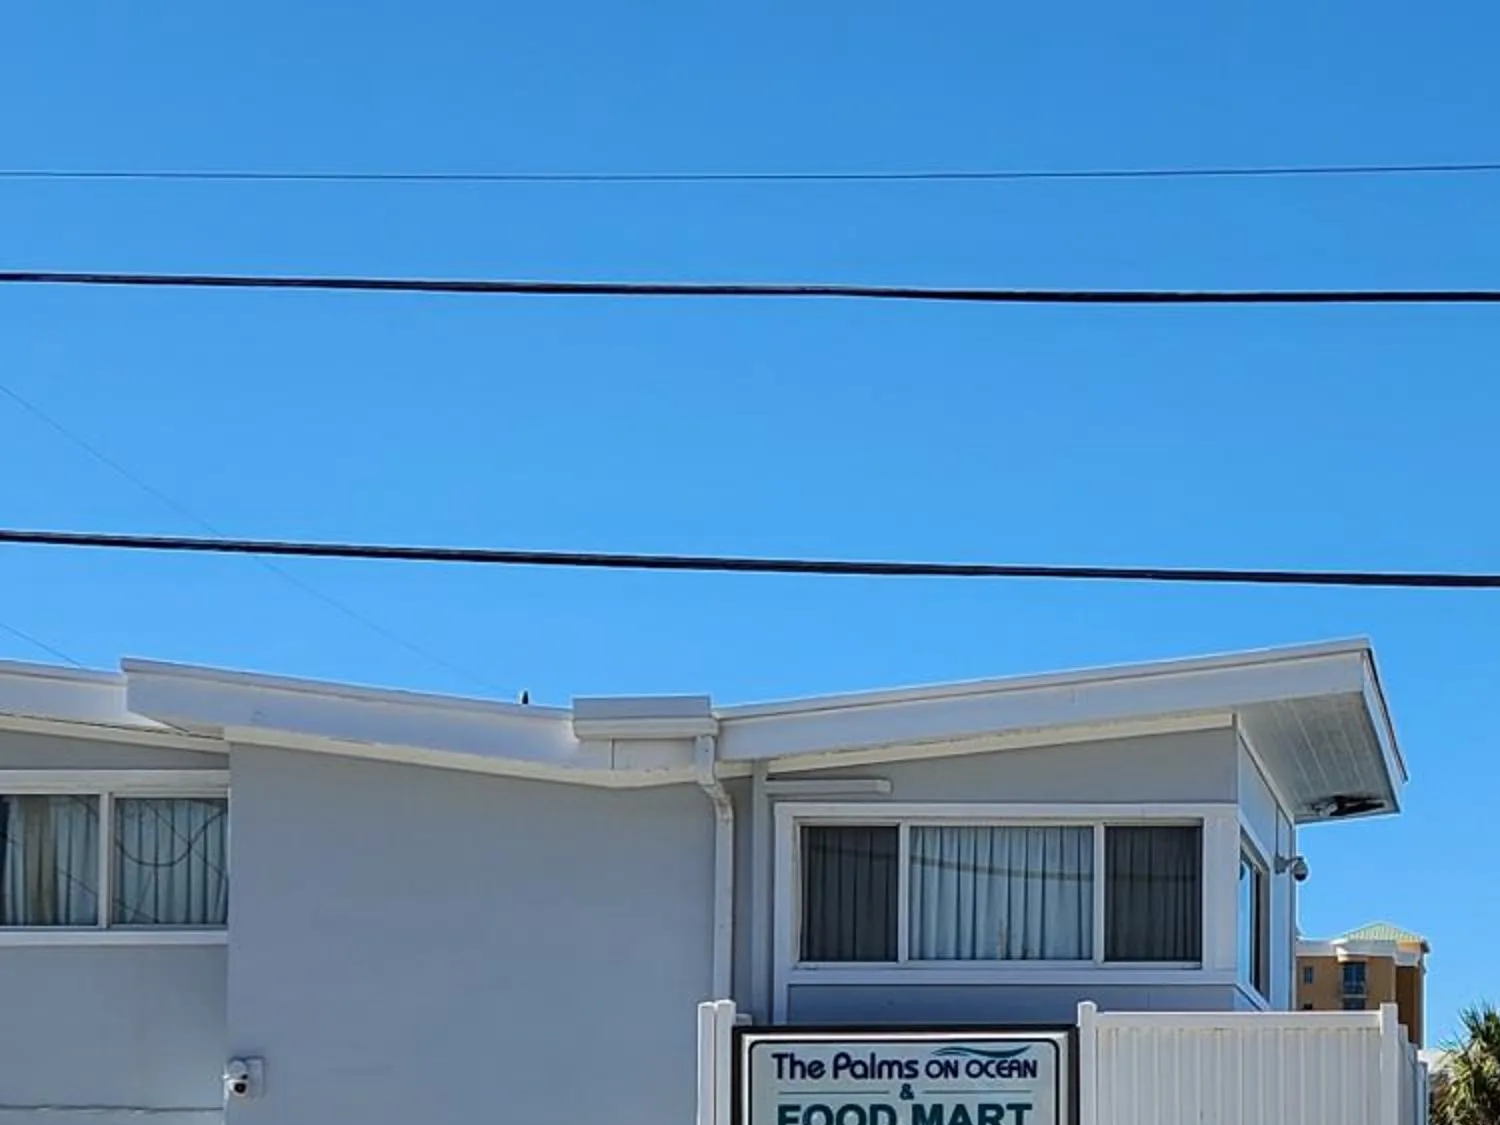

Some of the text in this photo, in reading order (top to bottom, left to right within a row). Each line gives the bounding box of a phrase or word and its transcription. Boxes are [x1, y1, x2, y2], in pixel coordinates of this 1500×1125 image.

[771, 1051, 1038, 1080] The Palms ON OCEAN
[899, 1083, 915, 1101] &
